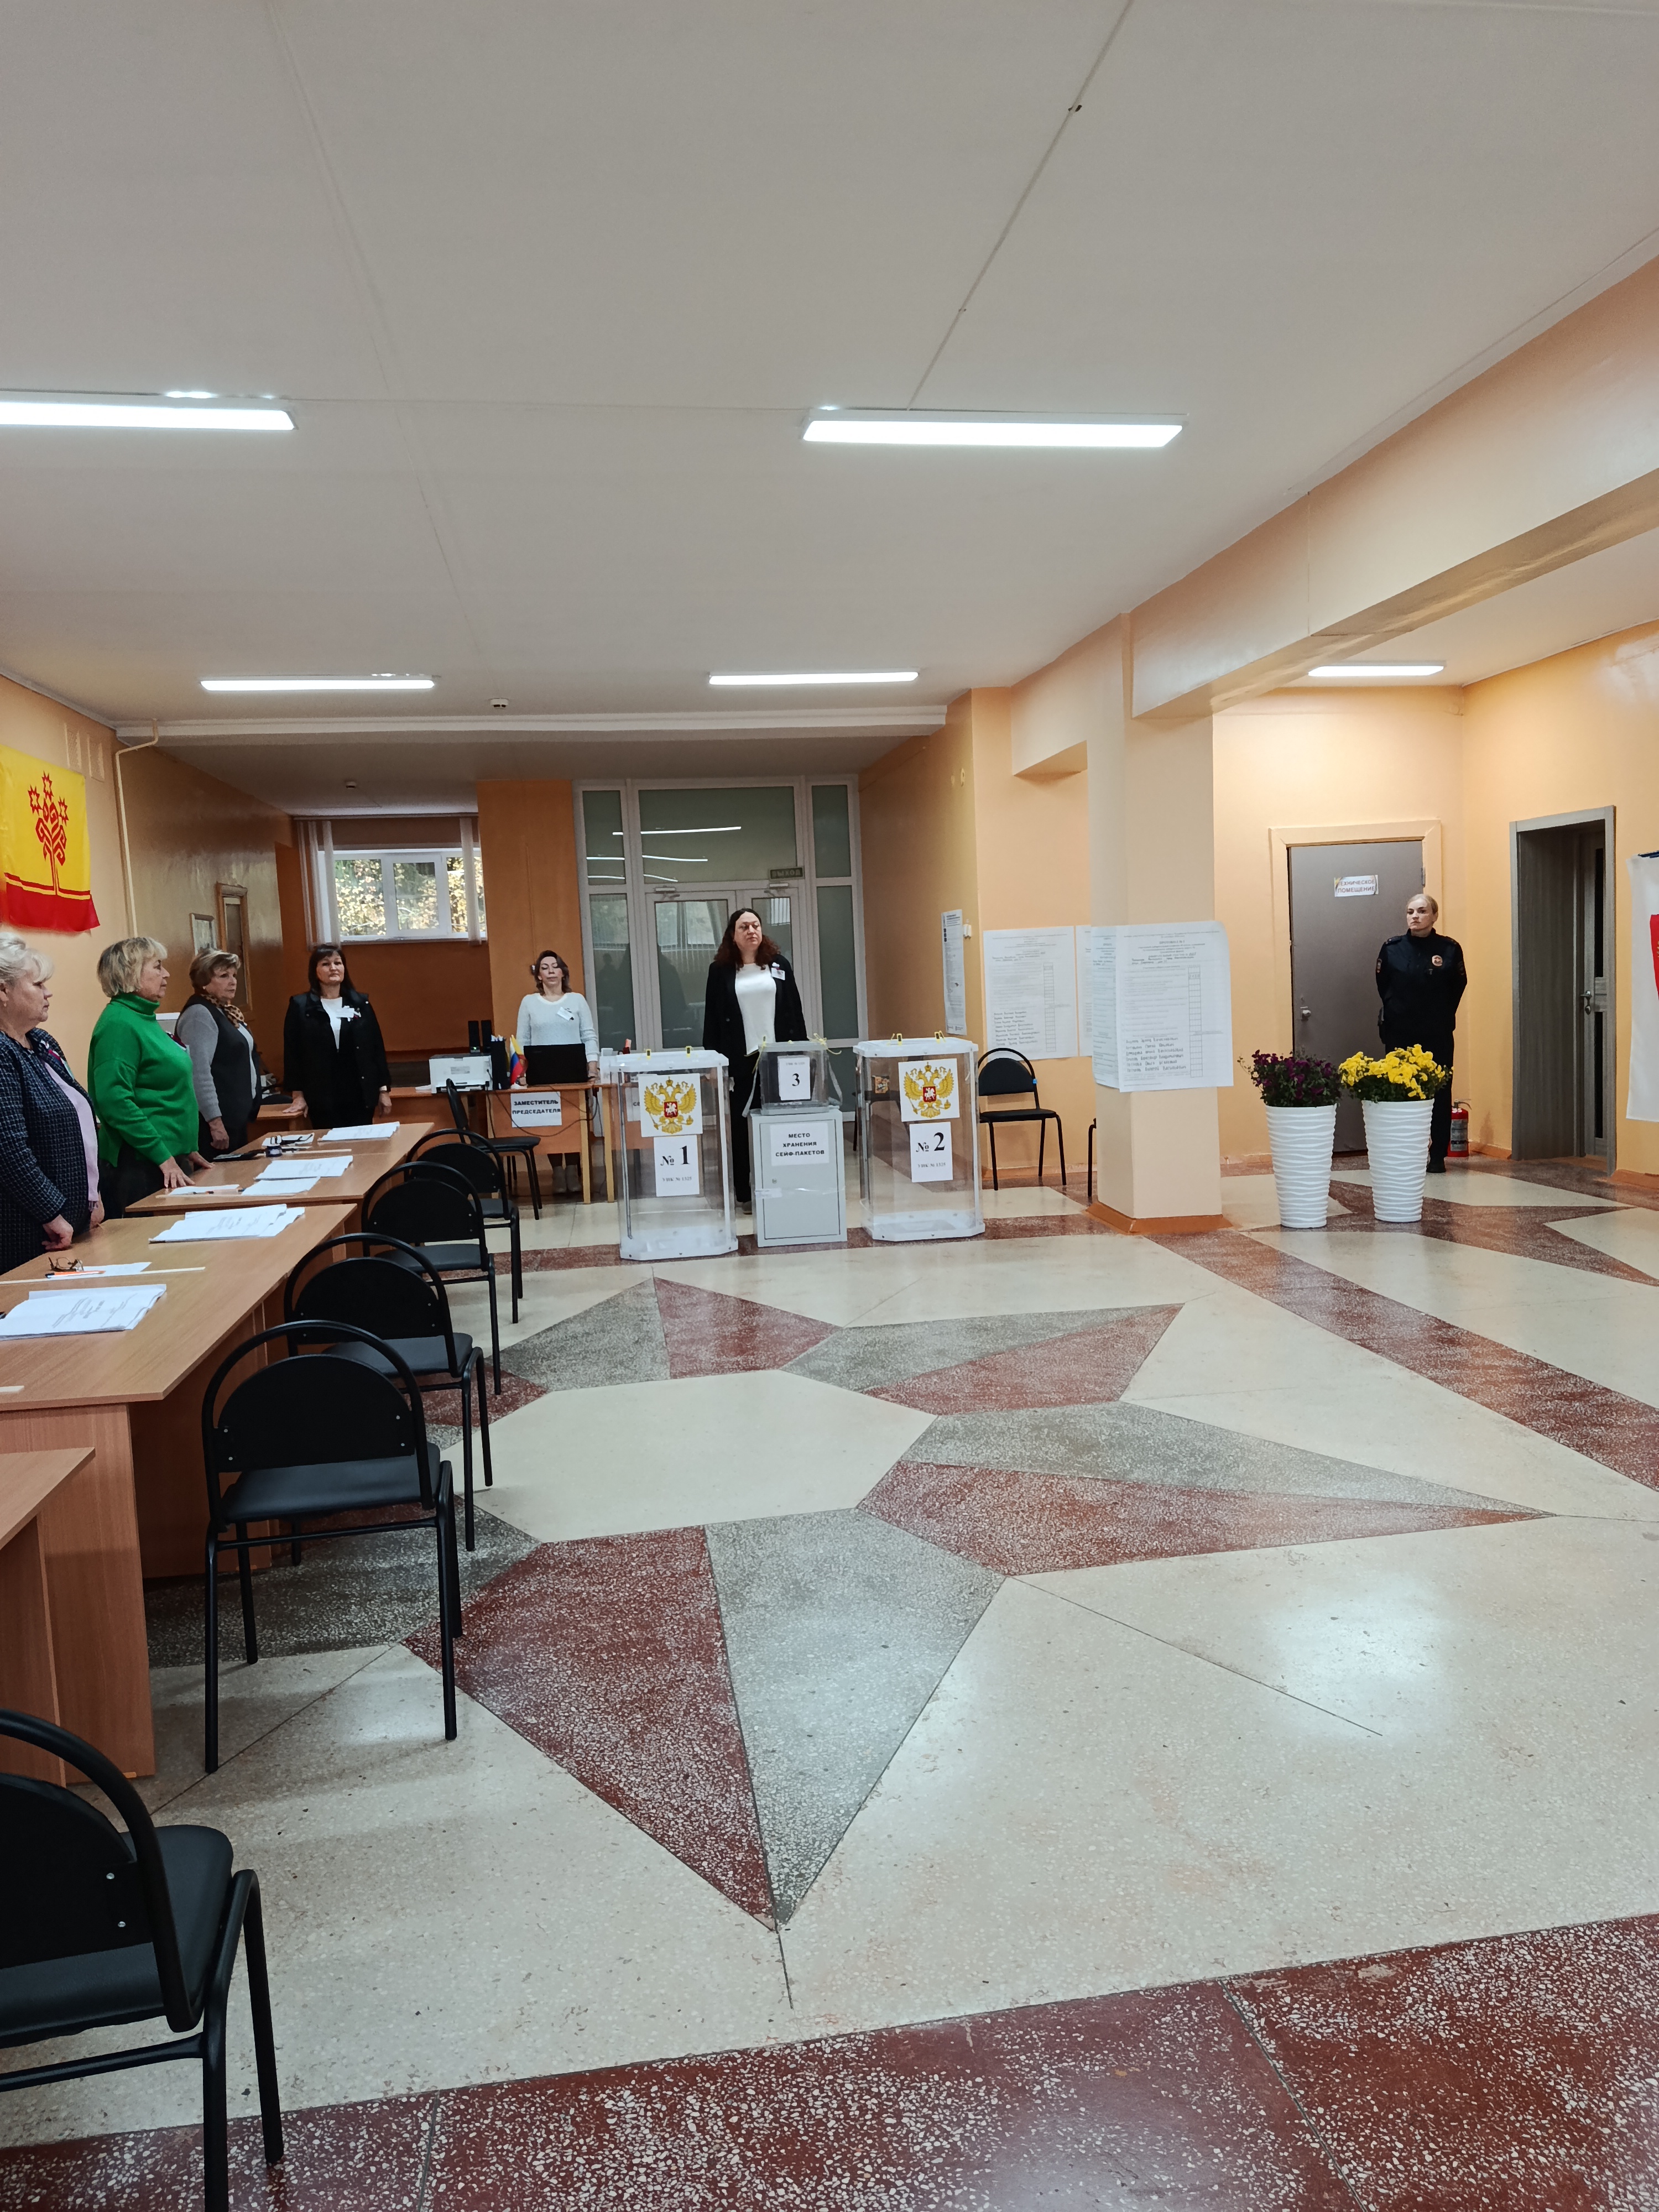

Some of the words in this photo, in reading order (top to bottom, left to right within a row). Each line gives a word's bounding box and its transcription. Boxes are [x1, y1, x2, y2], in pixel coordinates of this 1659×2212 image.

[792, 1073, 800, 1087] 3
[916, 1142, 929, 1152] №
[933, 1132, 946, 1151] 2
[660, 1155, 675, 1166] №
[680, 1145, 690, 1165] 1
